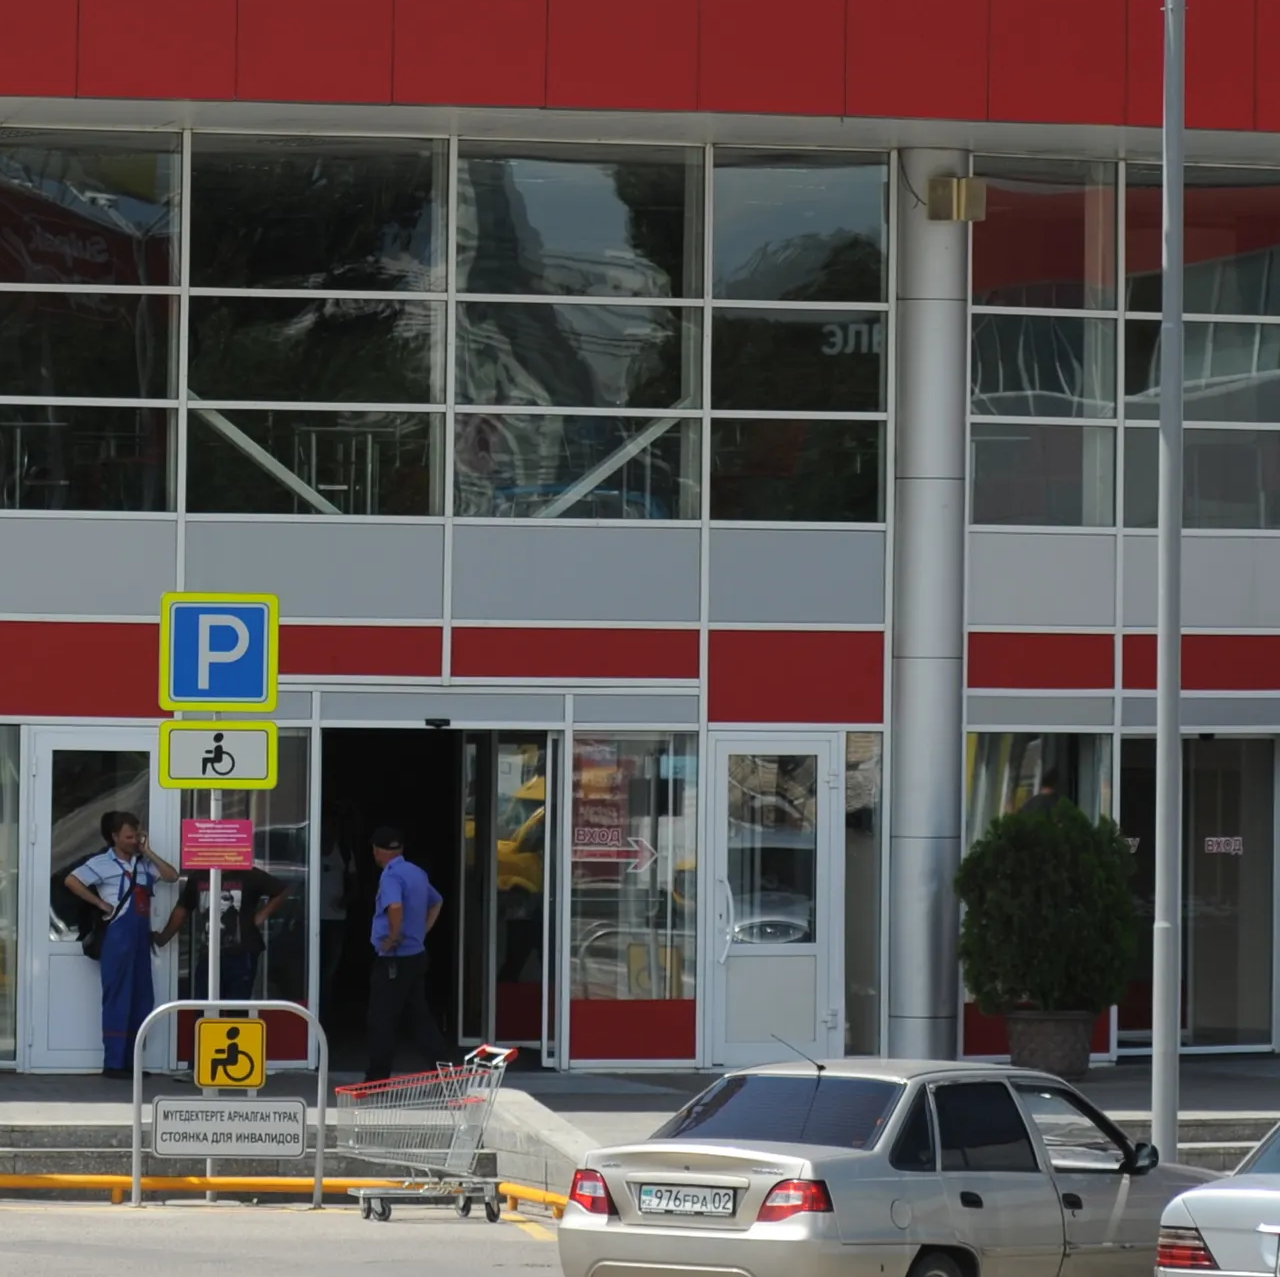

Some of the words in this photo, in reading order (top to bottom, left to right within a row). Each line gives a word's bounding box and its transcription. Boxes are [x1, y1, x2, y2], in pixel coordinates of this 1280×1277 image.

[199, 615, 249, 688] P
[575, 827, 622, 846] ВХОД
[1204, 837, 1243, 855] ВХОД
[160, 1131, 209, 1143] СТОЯНКА
[211, 1132, 233, 1144] ДЛЯ
[235, 1132, 300, 1146] ИНВАЛИДОВ
[712, 1191, 732, 1210] 02
